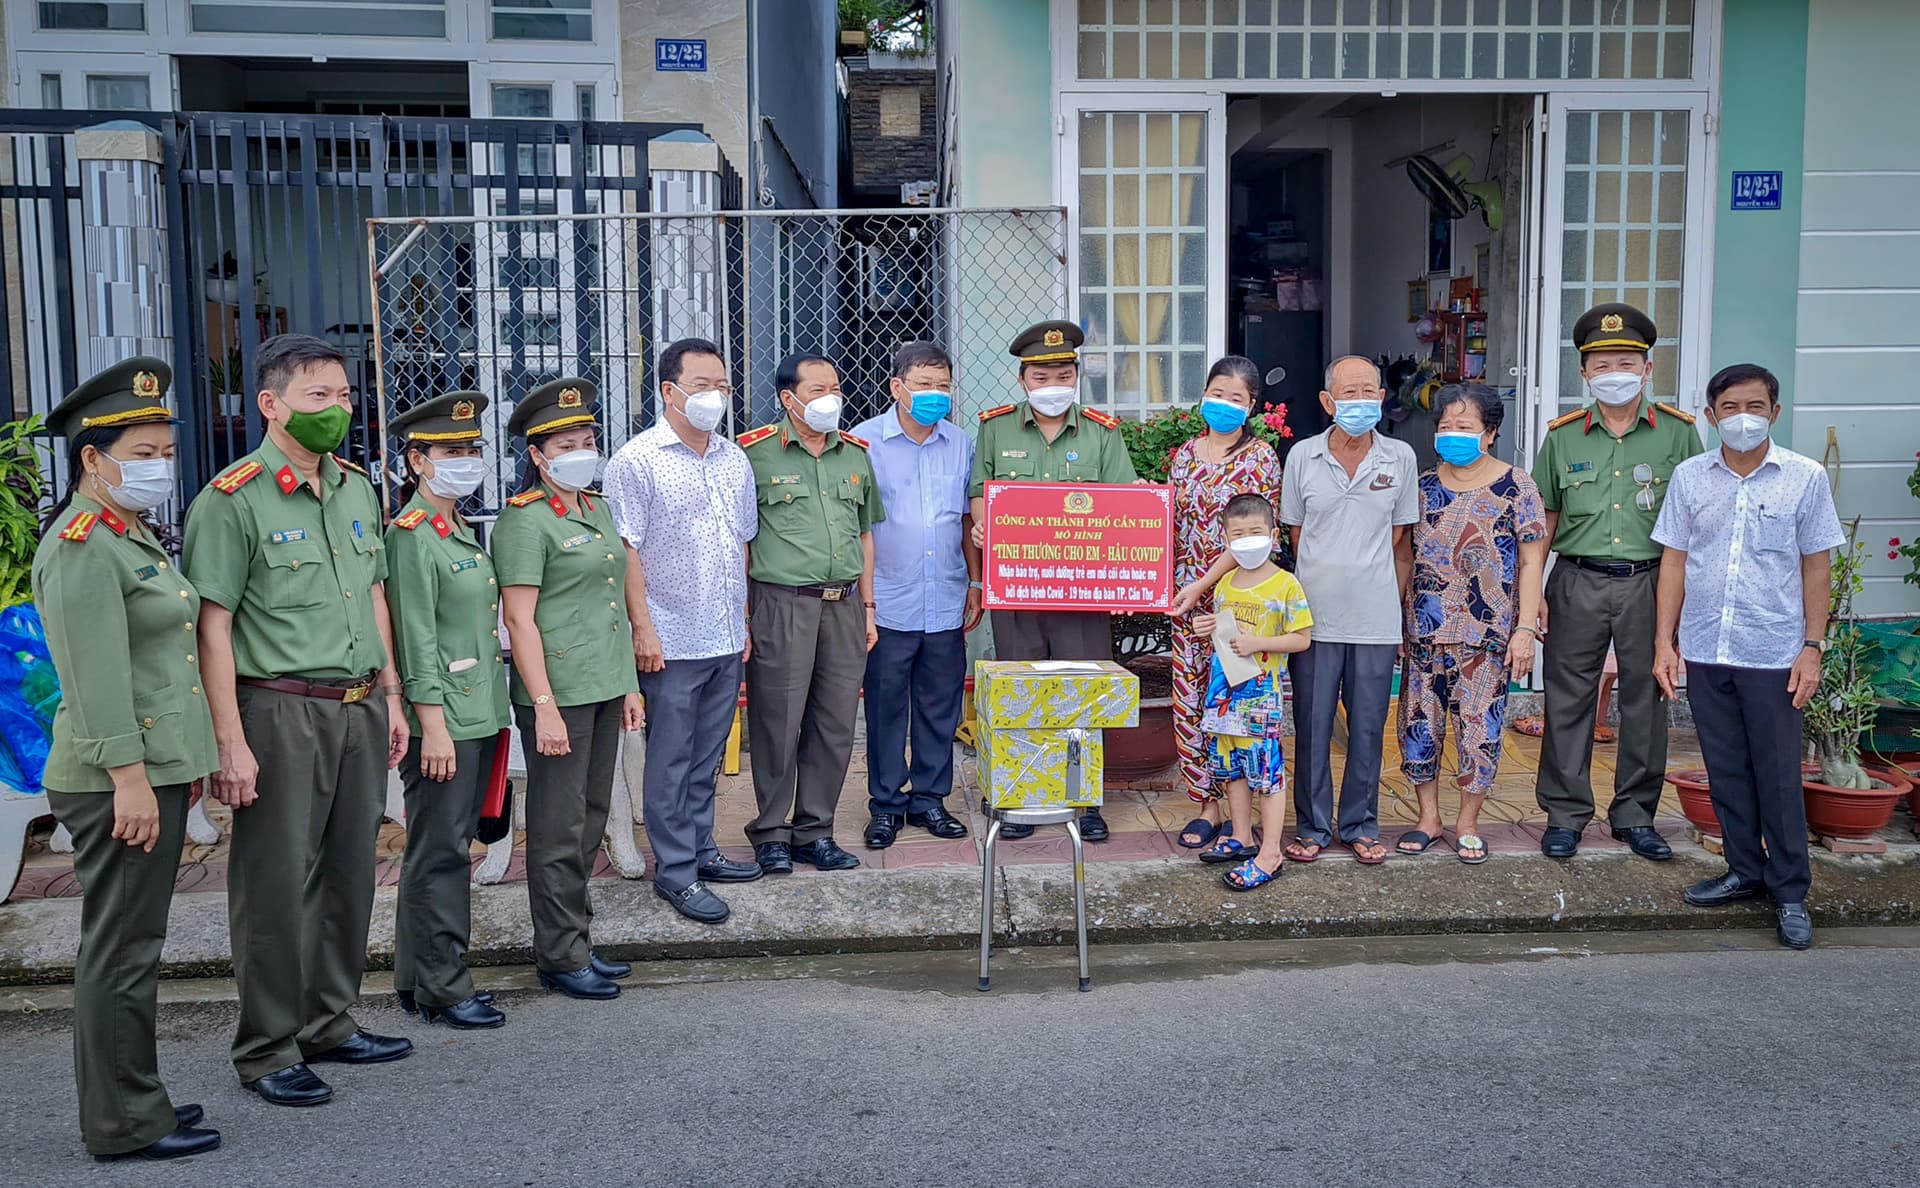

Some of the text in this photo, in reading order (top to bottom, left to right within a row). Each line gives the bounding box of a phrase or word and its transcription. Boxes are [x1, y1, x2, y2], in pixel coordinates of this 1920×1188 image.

[660, 44, 703, 63] 12/25
[1735, 175, 1778, 200] 12/25A
[995, 513, 1026, 526] CÔNG
[1028, 516, 1044, 526] AN
[1046, 515, 1085, 527] THÀNH
[1087, 514, 1111, 528] PHỐ
[1139, 516, 1162, 529] THƠ
[1054, 529, 1103, 540] MÔ HÌNH
[1022, 541, 1061, 560] THƯƠNG
[1063, 545, 1084, 561] CHO
[1086, 545, 1100, 561] EM
[1107, 541, 1129, 565] HẬU
[1047, 585, 1064, 599] Covid
[1069, 586, 1077, 599] 19
[1116, 586, 1127, 600] TP.
[1141, 587, 1154, 600] Thơ
